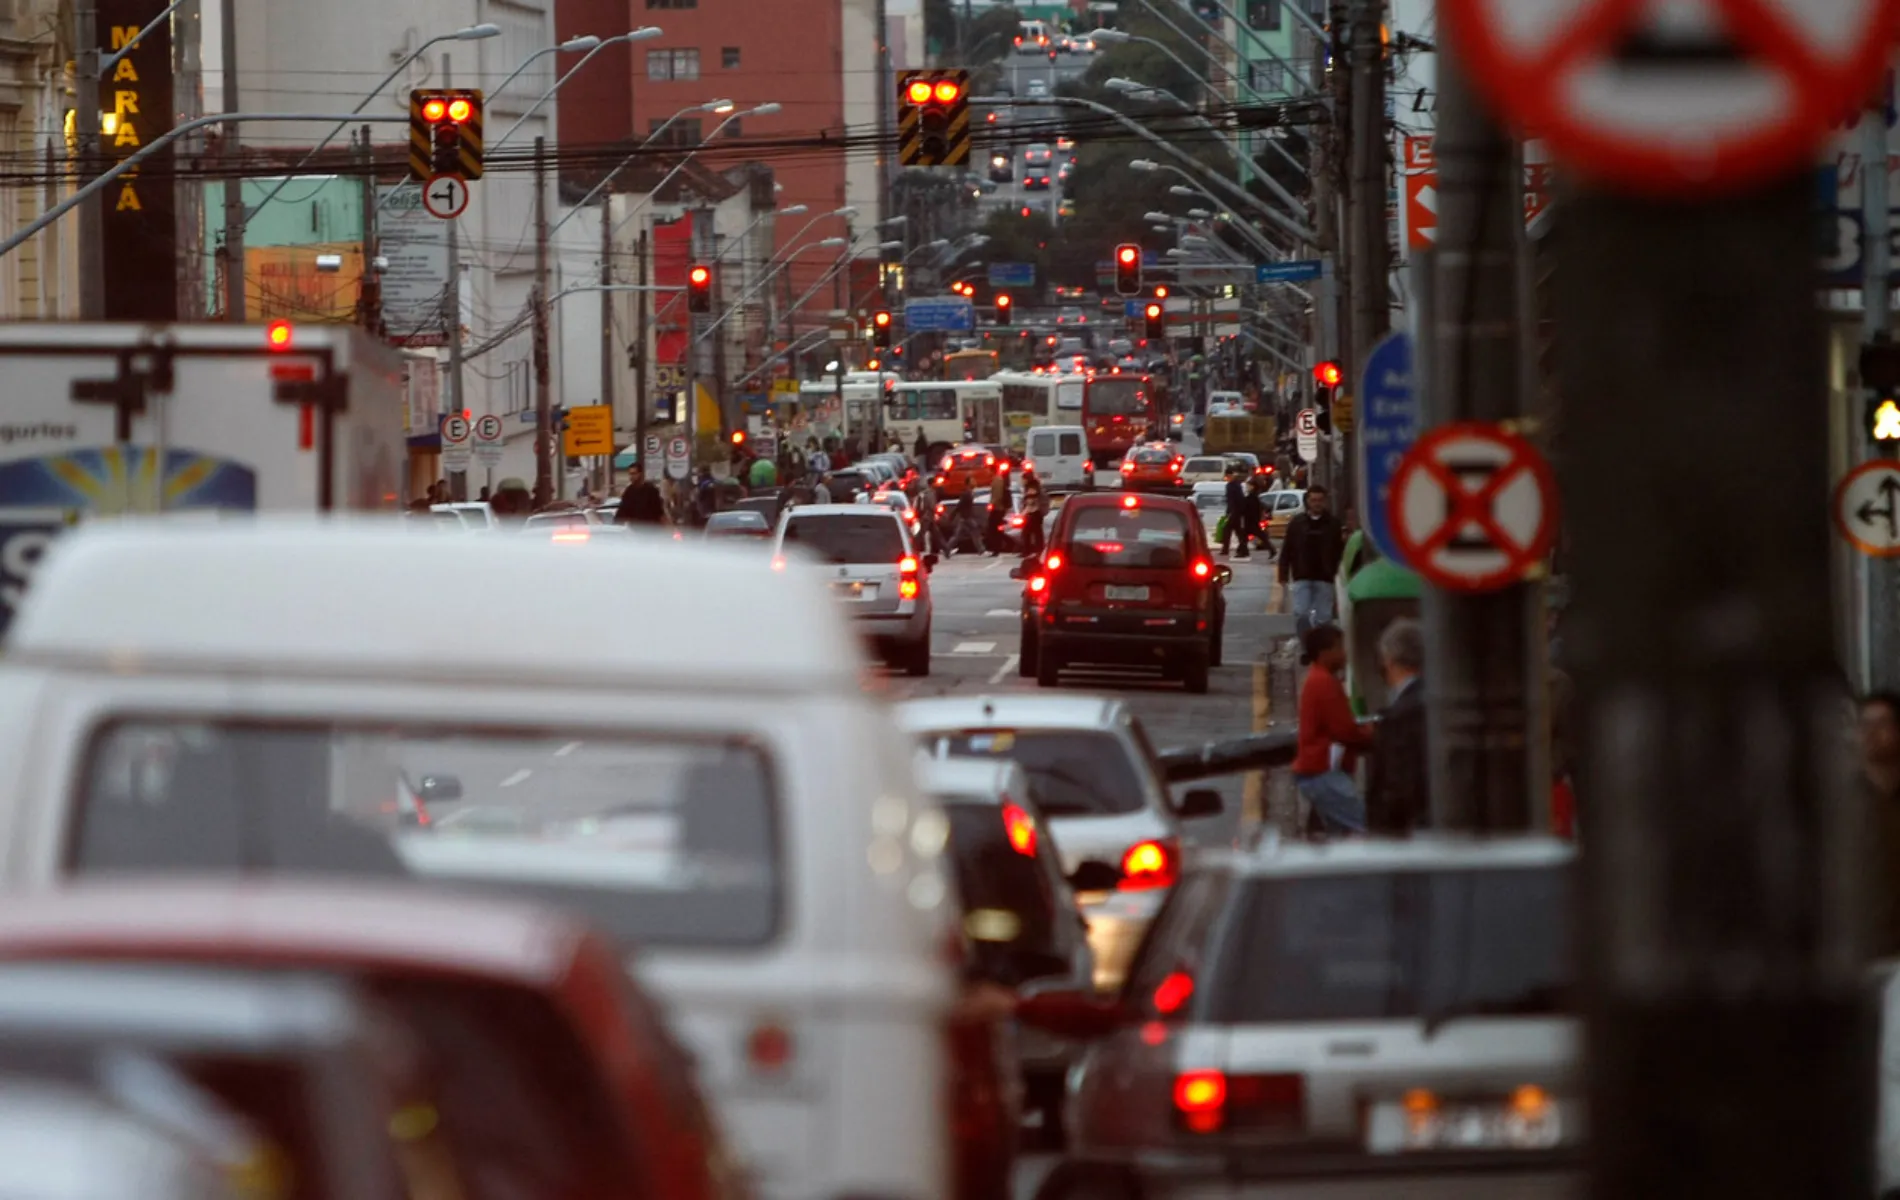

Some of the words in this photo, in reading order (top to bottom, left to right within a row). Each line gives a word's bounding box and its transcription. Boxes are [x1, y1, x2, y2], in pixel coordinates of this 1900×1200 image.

[450, 419, 463, 437] E
[483, 419, 494, 436] E
[1302, 413, 1314, 430] E
[646, 436, 657, 451] E
[673, 439, 684, 454] E
